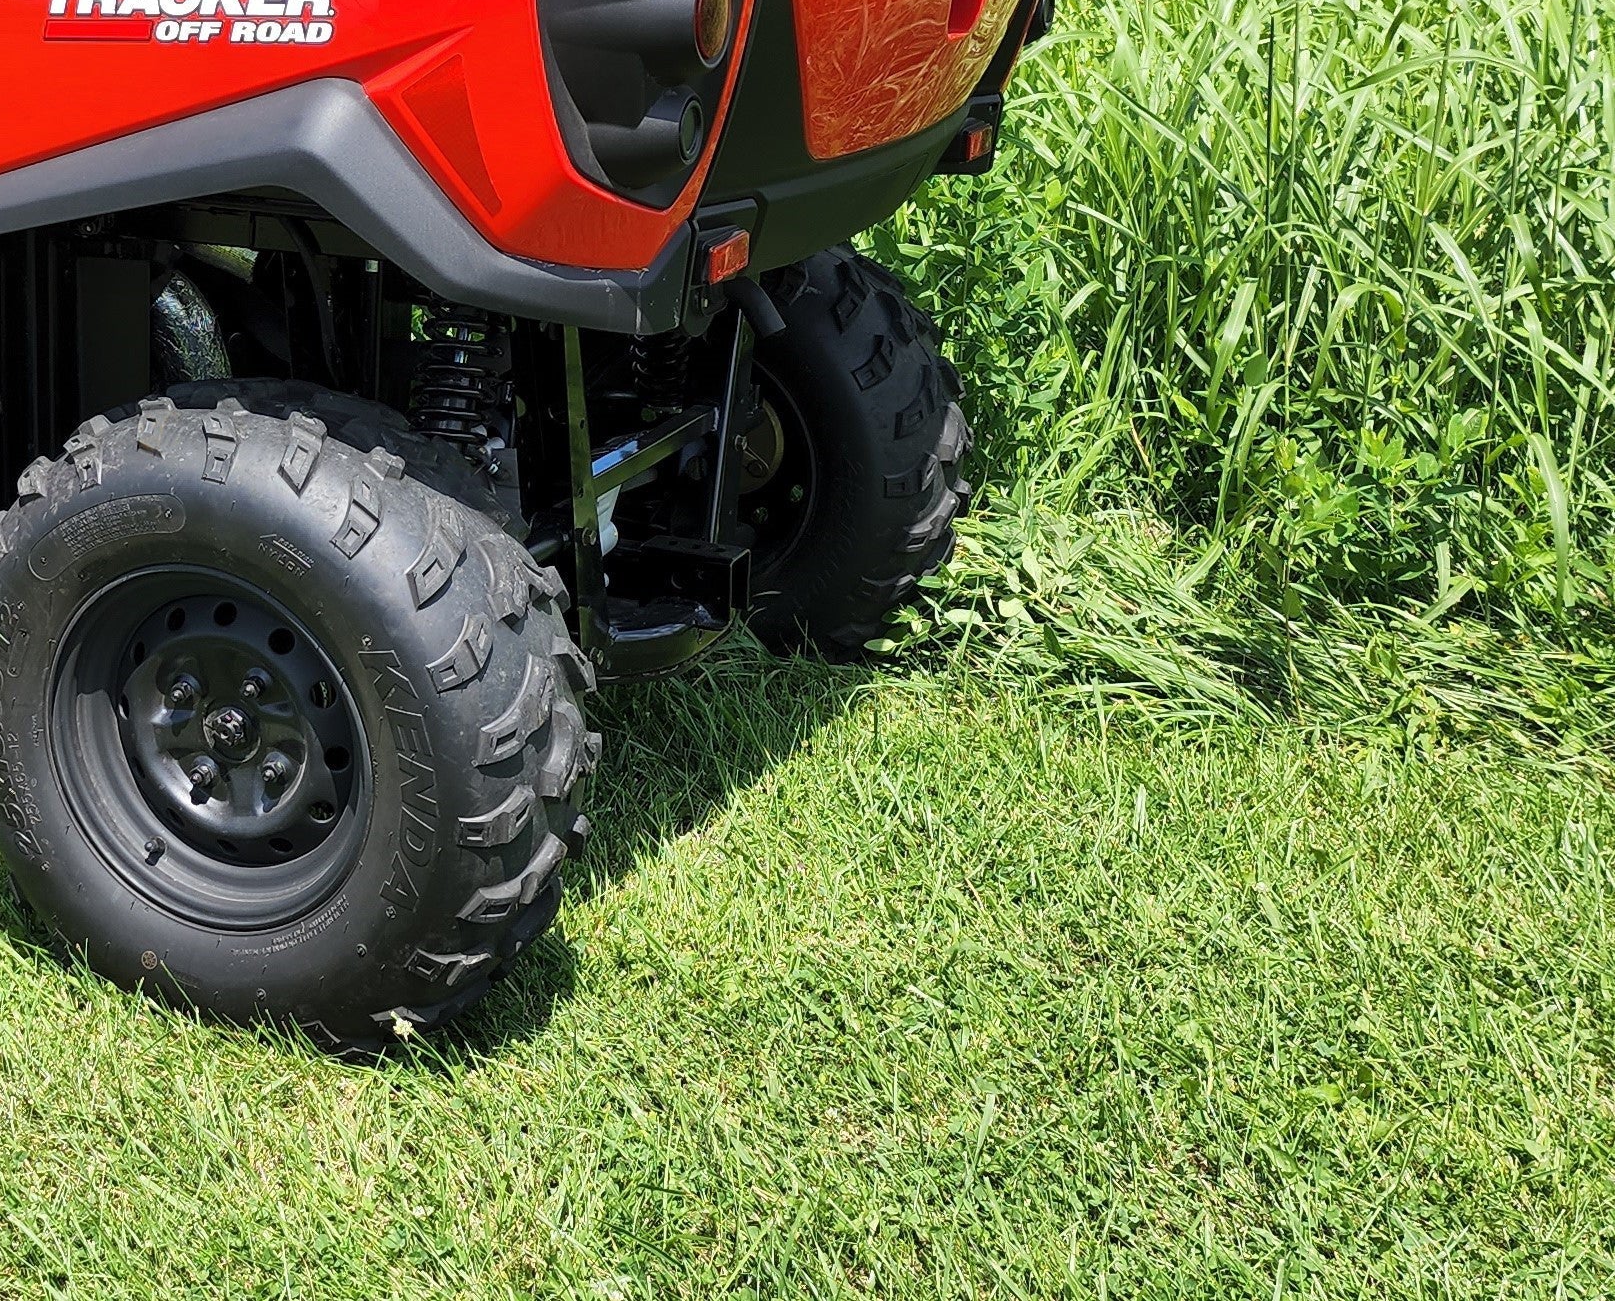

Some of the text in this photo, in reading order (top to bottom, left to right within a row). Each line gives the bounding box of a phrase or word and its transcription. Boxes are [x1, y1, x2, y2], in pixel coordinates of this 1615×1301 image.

[155, 20, 334, 43] OFF ROAD
[357, 649, 440, 912] KENDA
